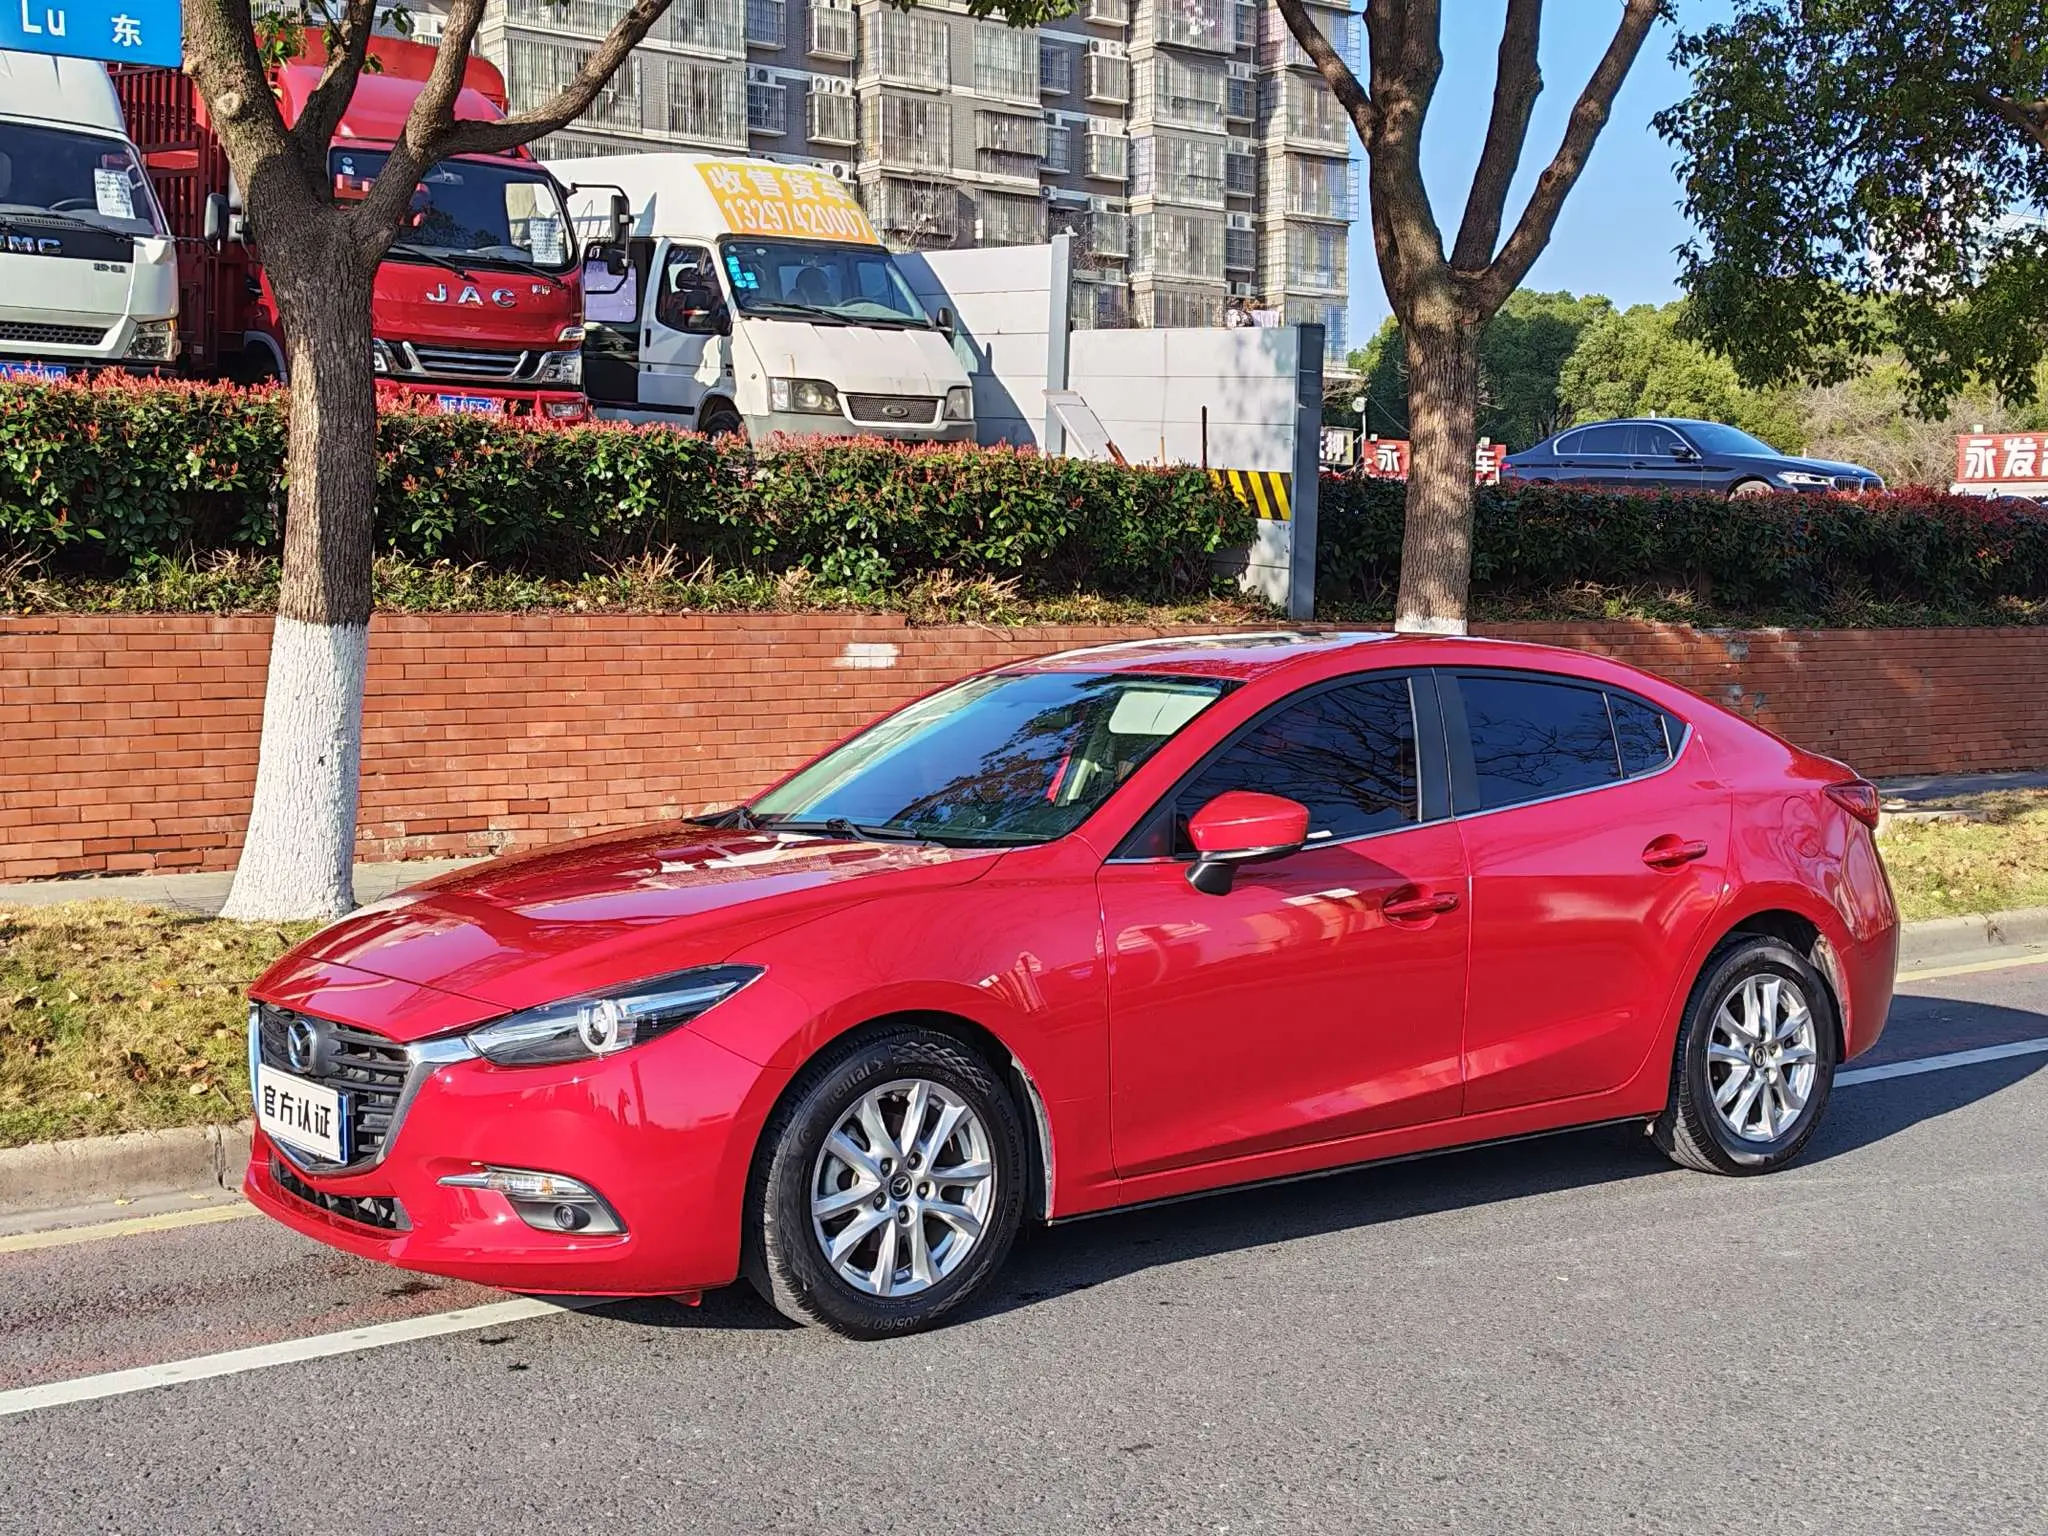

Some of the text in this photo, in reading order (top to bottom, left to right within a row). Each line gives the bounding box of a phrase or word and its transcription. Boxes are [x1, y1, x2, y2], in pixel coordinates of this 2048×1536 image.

[21, 0, 66, 37] Lu
[111, 13, 144, 47] 东
[707, 165, 852, 204] 收售货车
[723, 198, 869, 239] 13297420007
[426, 283, 516, 308] JAC
[1376, 444, 1401, 472] 永
[1965, 436, 2048, 479] 永发
[264, 1085, 331, 1139] 官方认证
